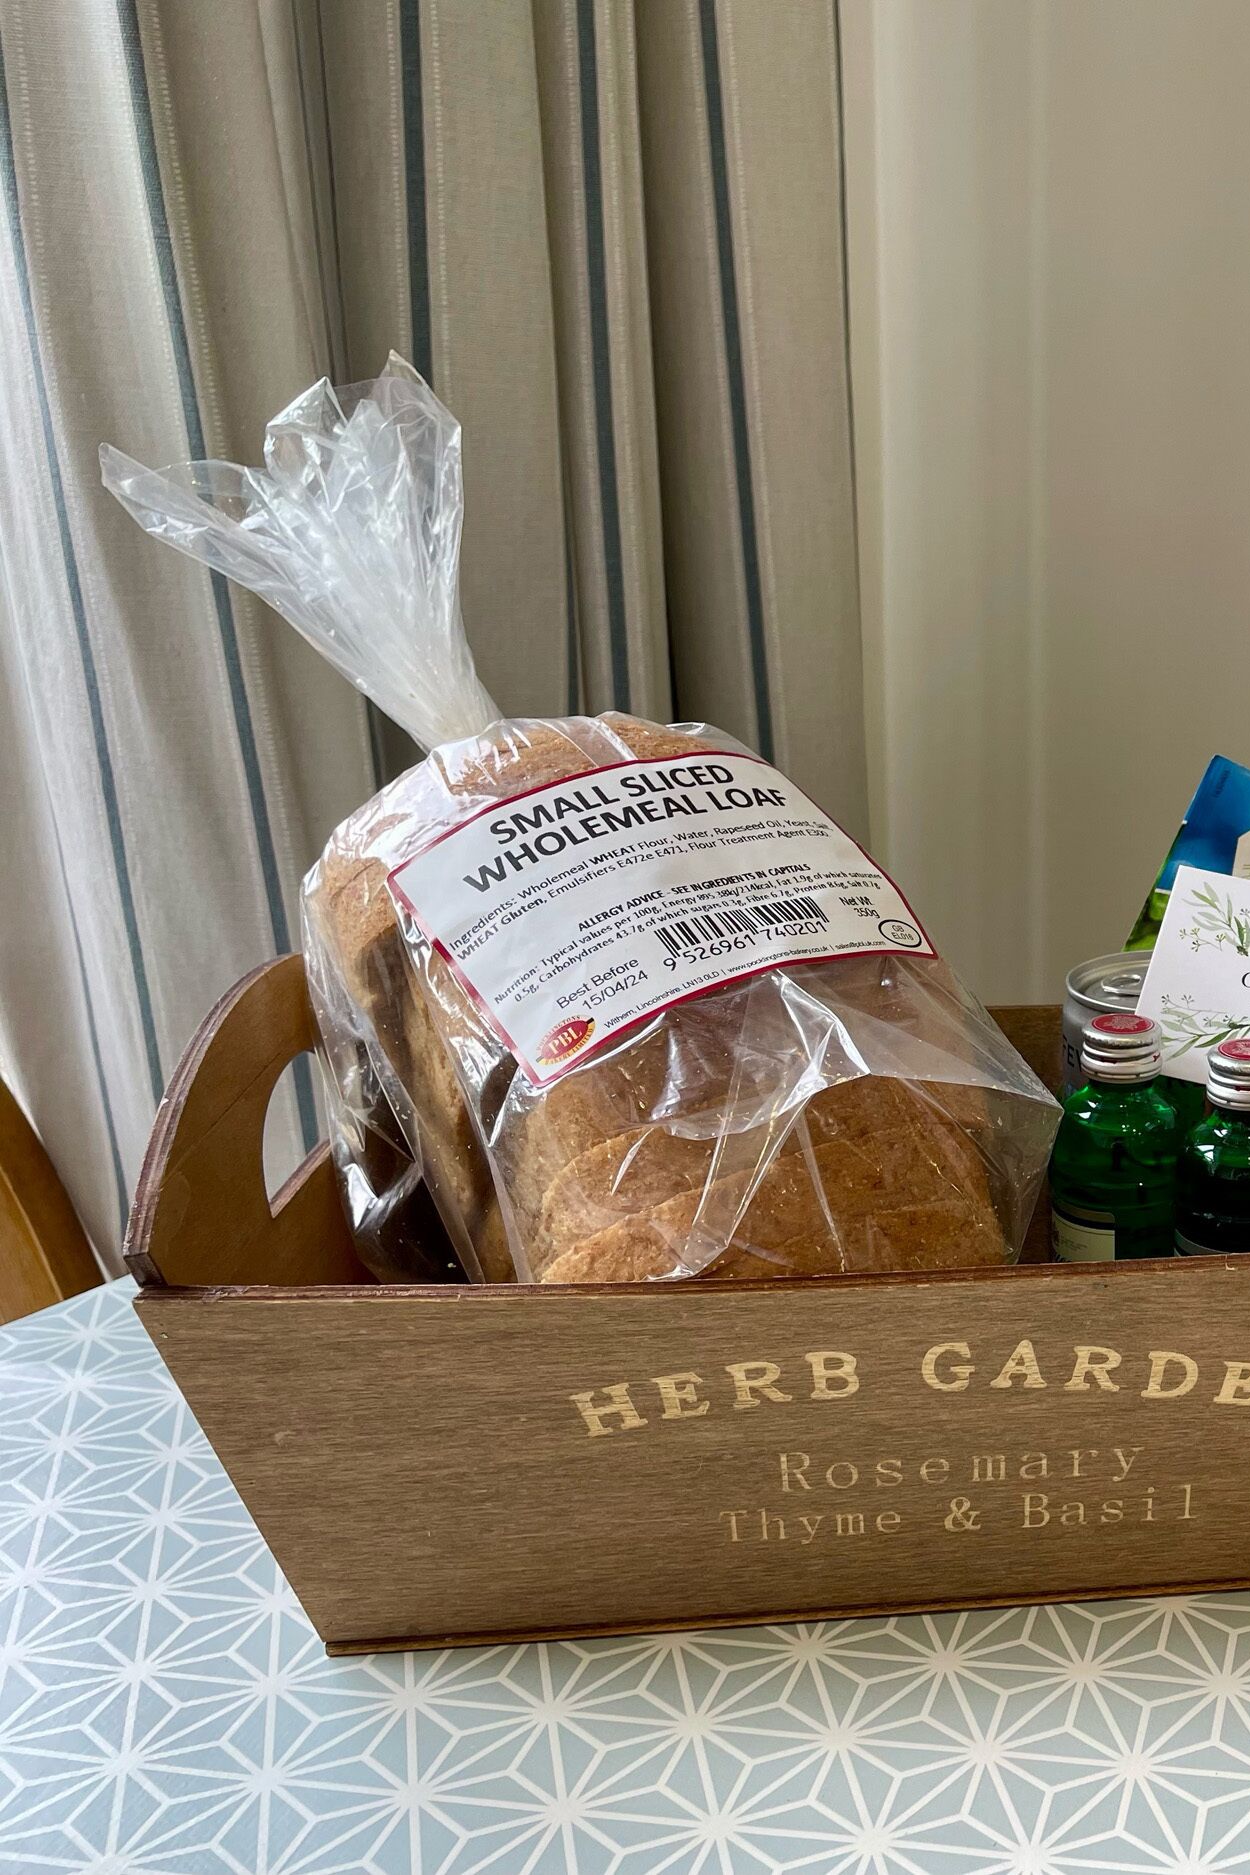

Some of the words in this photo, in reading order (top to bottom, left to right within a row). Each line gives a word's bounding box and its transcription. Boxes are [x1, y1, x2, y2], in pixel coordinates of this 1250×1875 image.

[490, 786, 620, 844] SMALL
[620, 765, 734, 797] SLICED
[463, 794, 708, 893] WHOLEMEAL
[705, 788, 787, 811] LOAF
[449, 897, 518, 951] Ingredients:
[517, 861, 588, 900] Wholemeal
[588, 845, 636, 866] WHEAT
[638, 836, 674, 851] Flour,
[673, 830, 714, 842] Water,
[714, 820, 765, 838] Rapeseed
[766, 819, 784, 829] Oil,
[457, 923, 502, 960] WHEAT
[500, 898, 548, 925] Gluten,
[547, 863, 616, 899] Emulsifiers
[617, 852, 654, 869] E472e
[656, 845, 688, 858] E471,
[689, 840, 719, 851] Flour
[720, 830, 774, 847] Treatment
[776, 829, 807, 840] Agent
[578, 904, 625, 932] ALLERGY
[626, 890, 665, 911] ADVICE
[671, 885, 692, 895] SEE
[693, 871, 755, 892] INGREDIENTS
[755, 869, 767, 879] IN
[767, 863, 812, 876] CAPITALS
[839, 896, 859, 907] Net
[853, 907, 881, 919] 350g
[494, 965, 540, 1005] Nutrition:
[541, 940, 578, 968] Typical
[579, 925, 613, 944] values
[613, 916, 632, 929] per
[633, 906, 662, 920] 100g,
[662, 896, 696, 909] Energy
[777, 879, 792, 890] Fat
[813, 871, 823, 881] of
[823, 871, 848, 880] which
[539, 938, 615, 983] Carbohydrates
[615, 922, 646, 940] 43.7g
[645, 917, 657, 928] of
[657, 907, 689, 923] which
[690, 902, 722, 913] sugars
[745, 892, 771, 903] Fibre
[795, 882, 826, 895] Protein
[663, 957, 677, 972] 9
[683, 933, 756, 964] 526961
[759, 920, 828, 941] 740201
[891, 925, 905, 933] GB
[556, 981, 592, 1009] Best
[591, 958, 640, 987] Before
[582, 969, 649, 1011] 15/04/24
[683, 976, 705, 990] LN13
[548, 1027, 583, 1055] PBL
[569, 1350, 860, 1438] HERB
[778, 1446, 1145, 1493] Rosemary
[719, 1507, 902, 1545] Thyme
[943, 1496, 982, 1533] &
[1020, 1484, 1199, 1529] Basil
